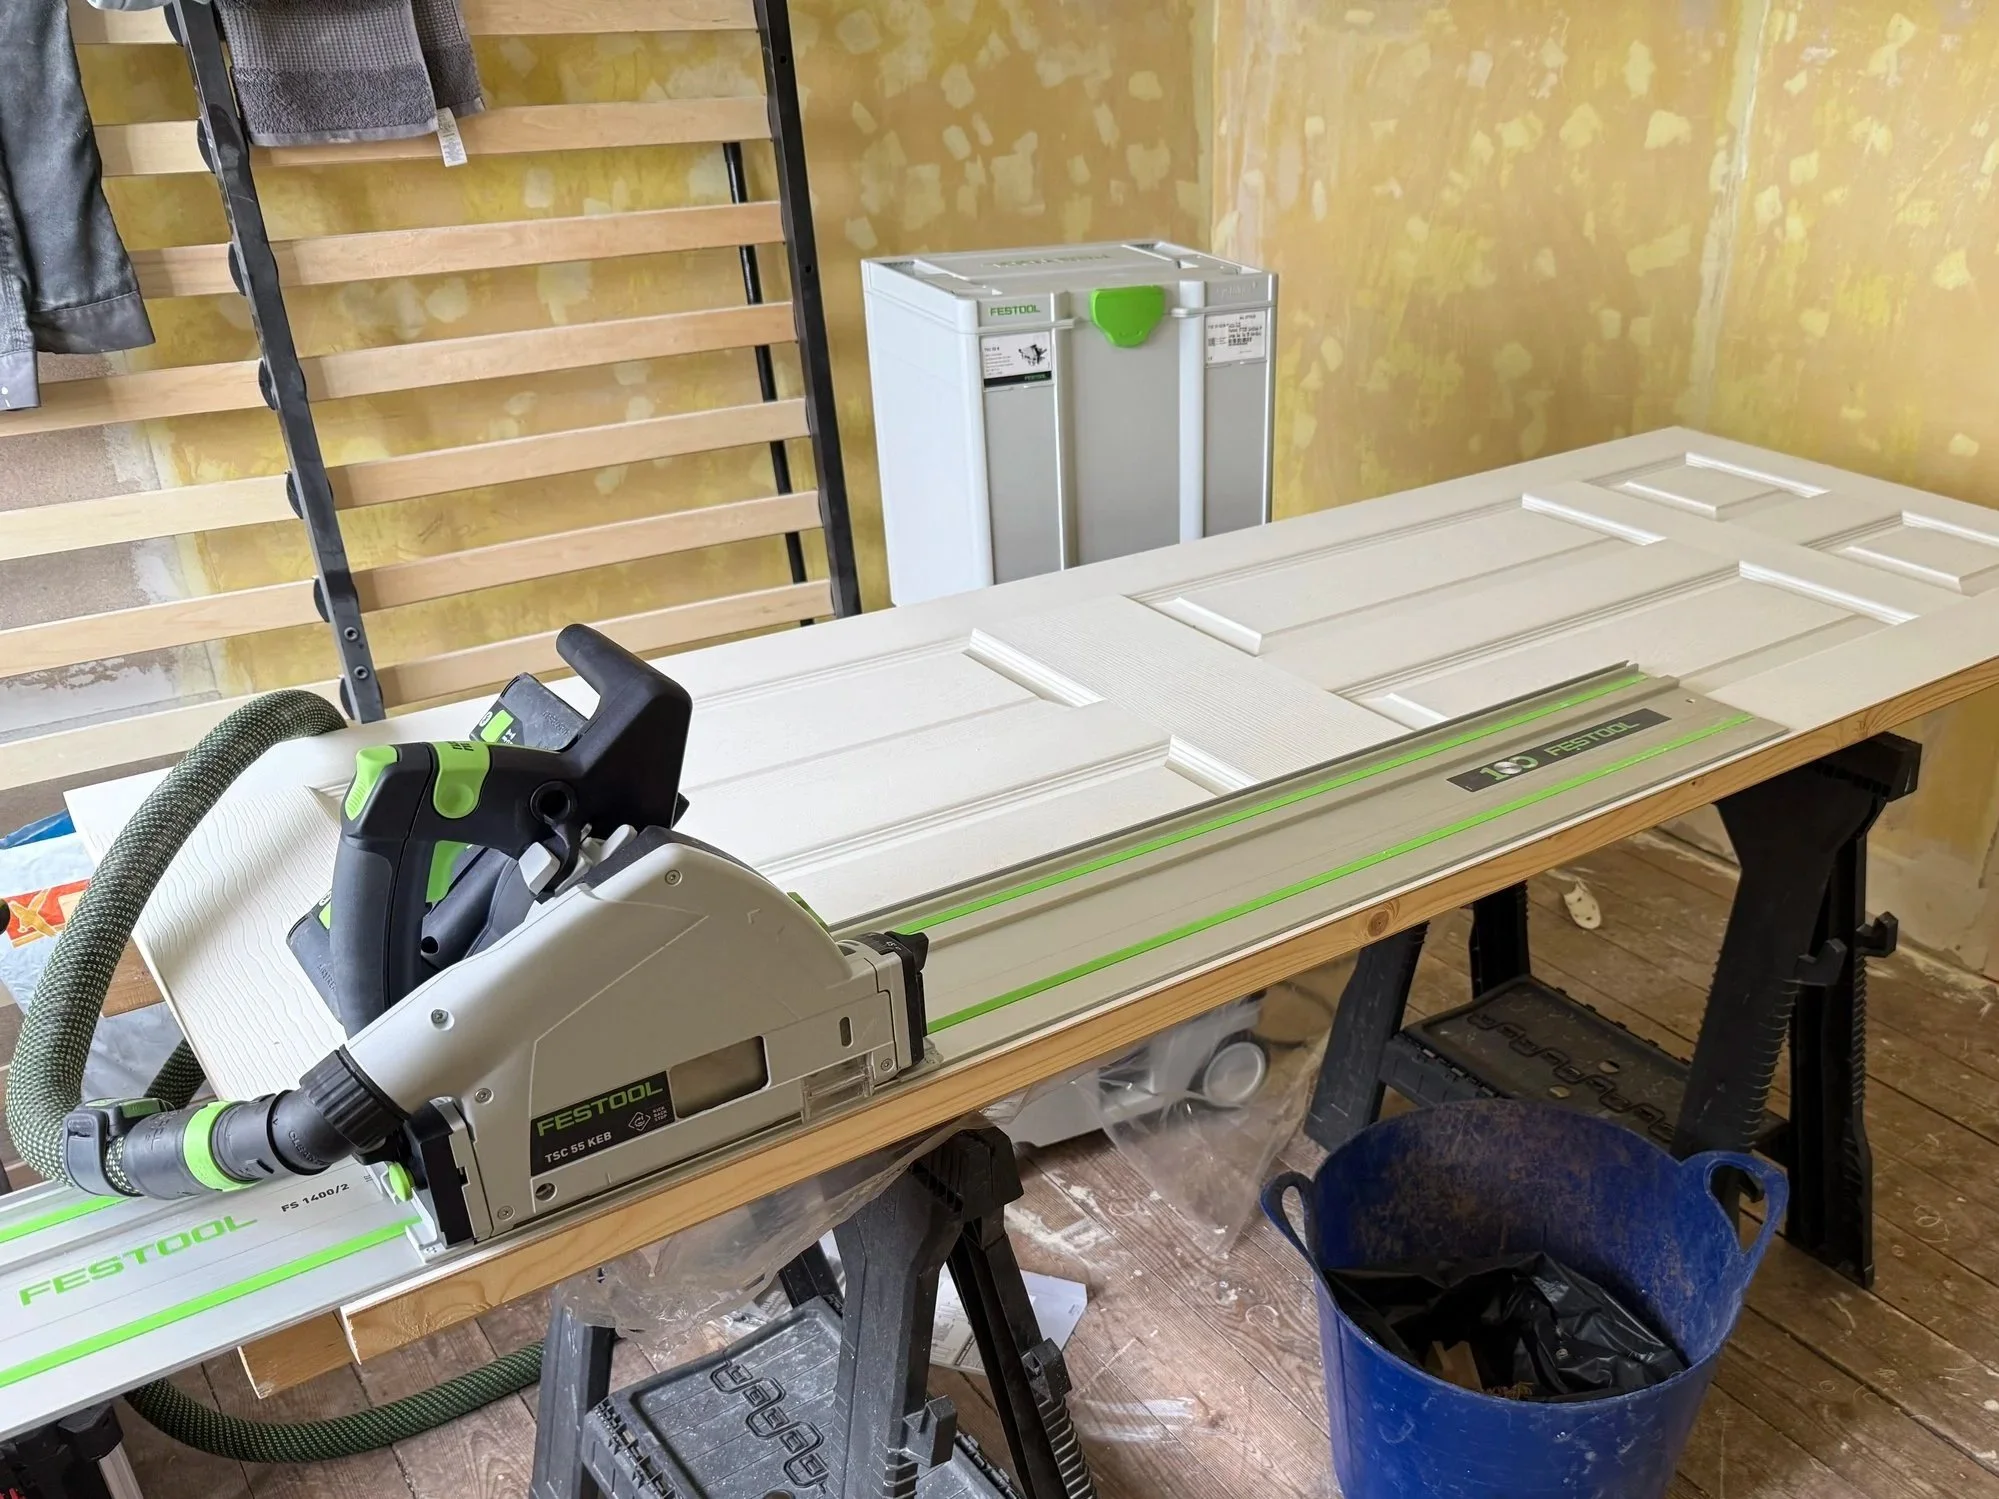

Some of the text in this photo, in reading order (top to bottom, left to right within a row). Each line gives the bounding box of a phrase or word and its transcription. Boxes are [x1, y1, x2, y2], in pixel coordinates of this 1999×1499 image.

[990, 304, 1040, 317] FESTOOL
[1544, 721, 1640, 757] FESTOOL
[537, 1081, 663, 1136] FESTOOL
[544, 1131, 612, 1163] TSC 55 KEB
[281, 1182, 350, 1212] FS 1400/2
[19, 1215, 257, 1308] FESTOOL
